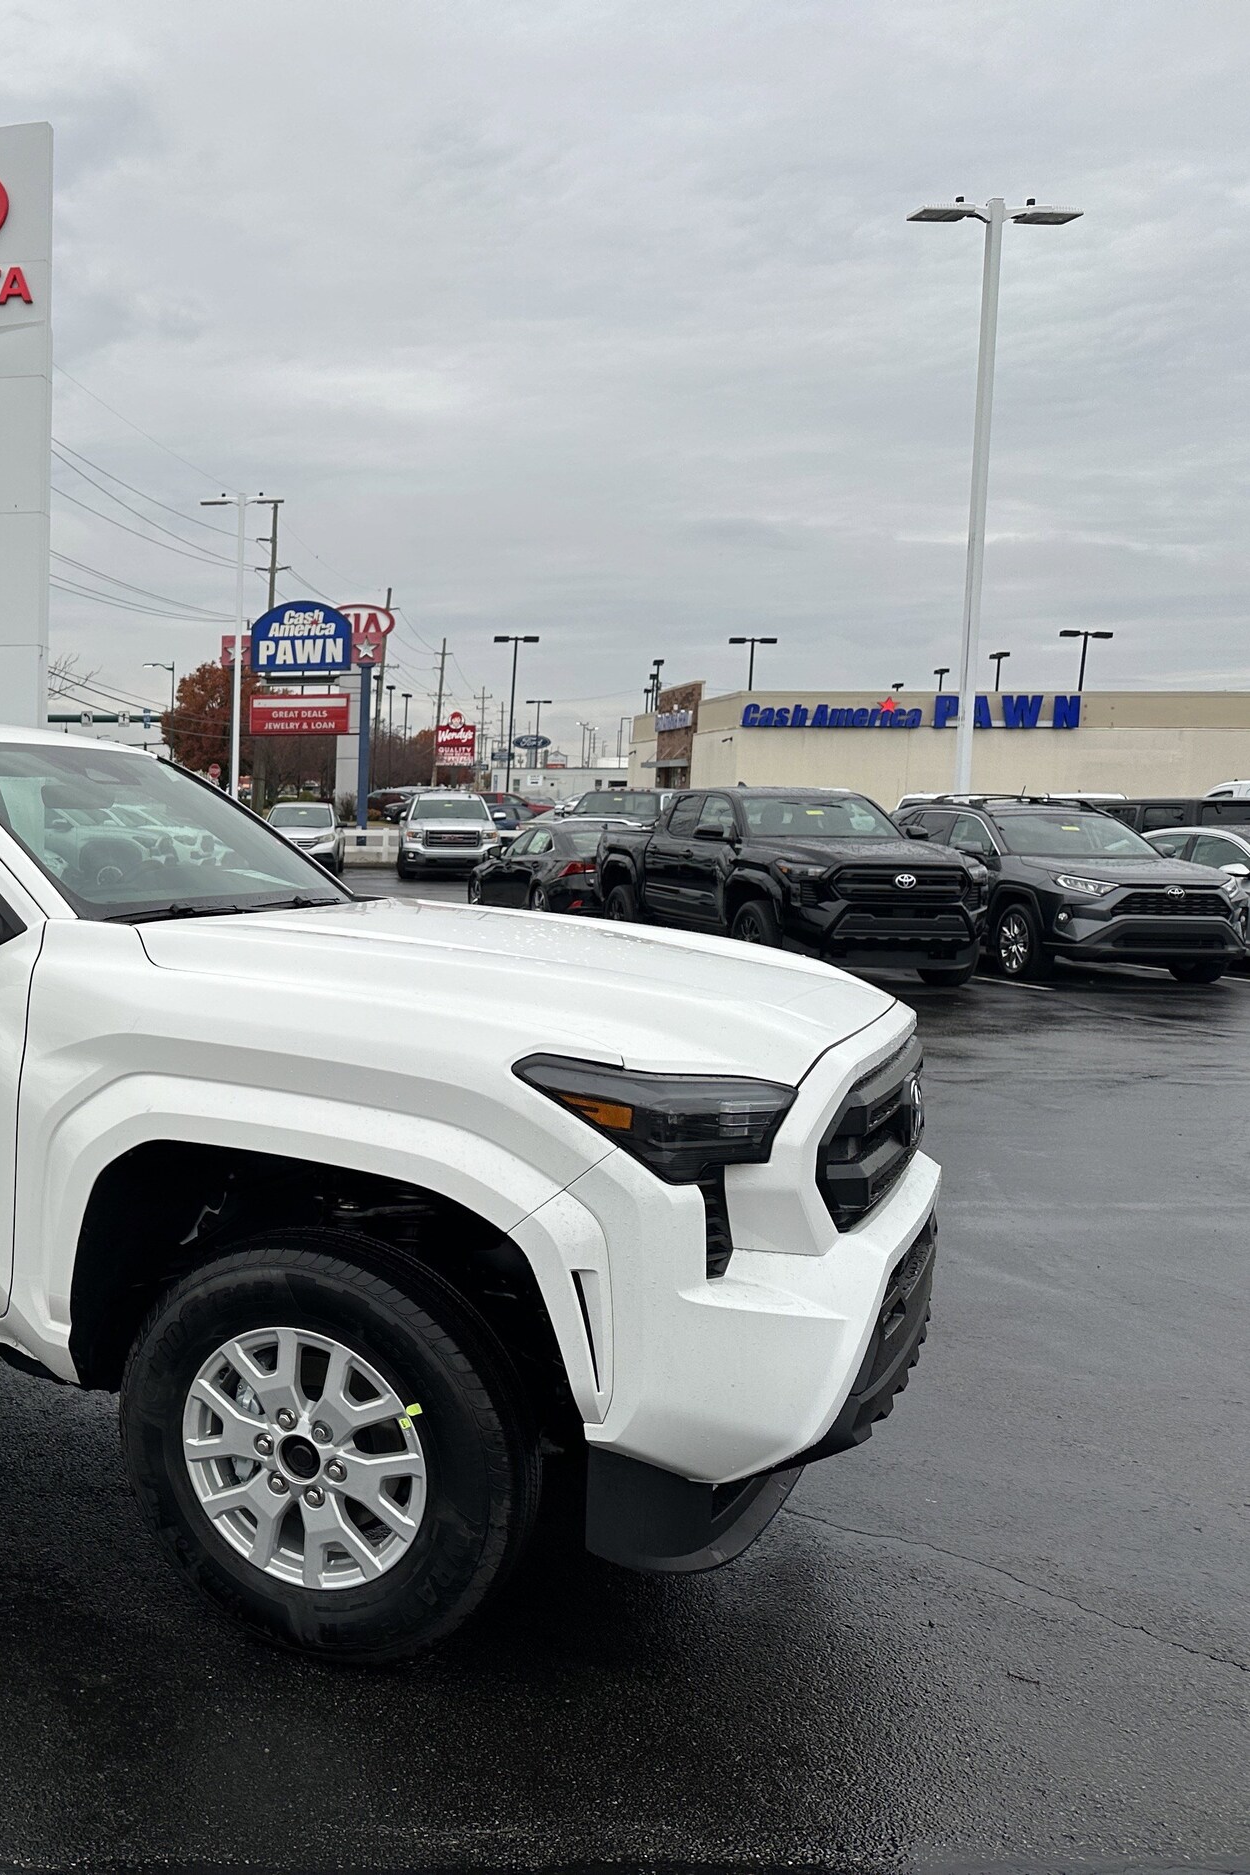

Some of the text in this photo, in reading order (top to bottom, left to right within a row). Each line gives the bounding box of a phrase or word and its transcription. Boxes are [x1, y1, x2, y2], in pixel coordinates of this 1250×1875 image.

[283, 609, 324, 625] Cash
[344, 612, 383, 633] IA
[268, 622, 336, 637] America
[258, 638, 344, 665] PAWN
[272, 710, 328, 718] GREAT DEALS
[741, 695, 1081, 729] Cash America PAWN
[264, 722, 300, 730] JEWELRY
[311, 721, 336, 729] LOAN
